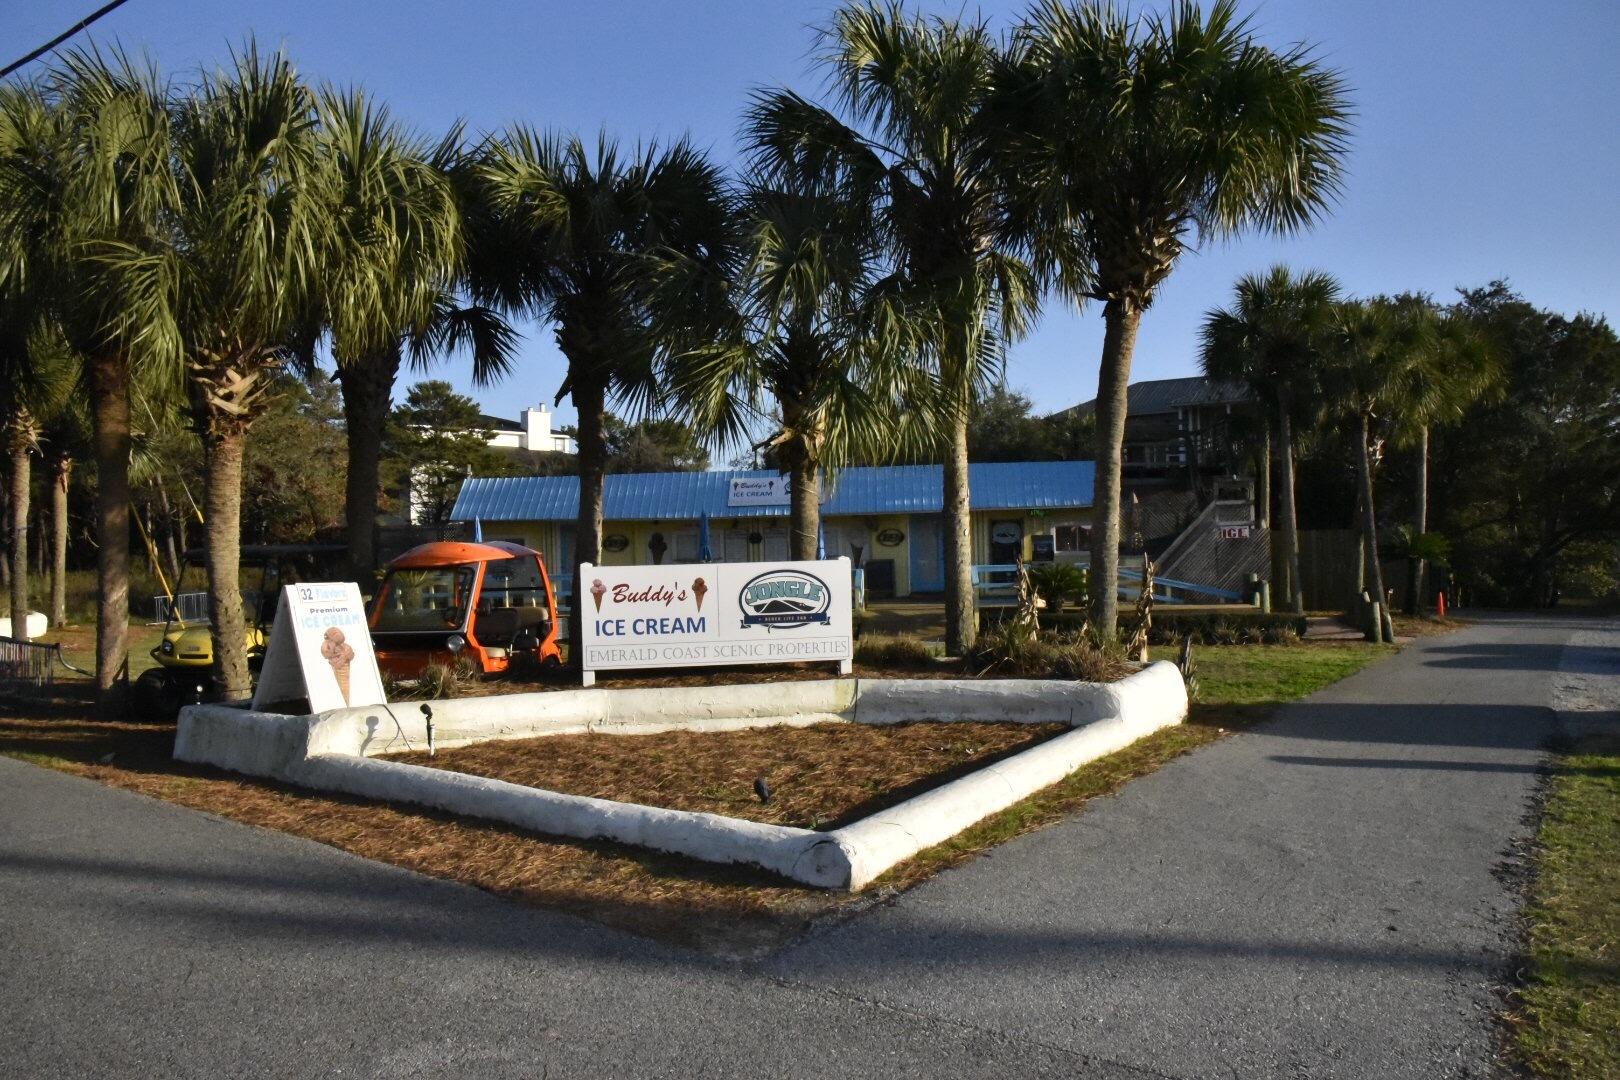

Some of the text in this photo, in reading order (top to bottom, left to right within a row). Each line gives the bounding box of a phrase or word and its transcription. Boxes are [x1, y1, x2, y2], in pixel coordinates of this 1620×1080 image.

[300, 588, 313, 600] 32
[611, 582, 688, 608] Buddy's
[310, 606, 348, 614] Premium
[302, 613, 361, 629] ICE CREAM
[595, 616, 706, 637] ICE CREAM
[590, 640, 847, 663] EMERALD COAST SCENIC PROPERTIES
